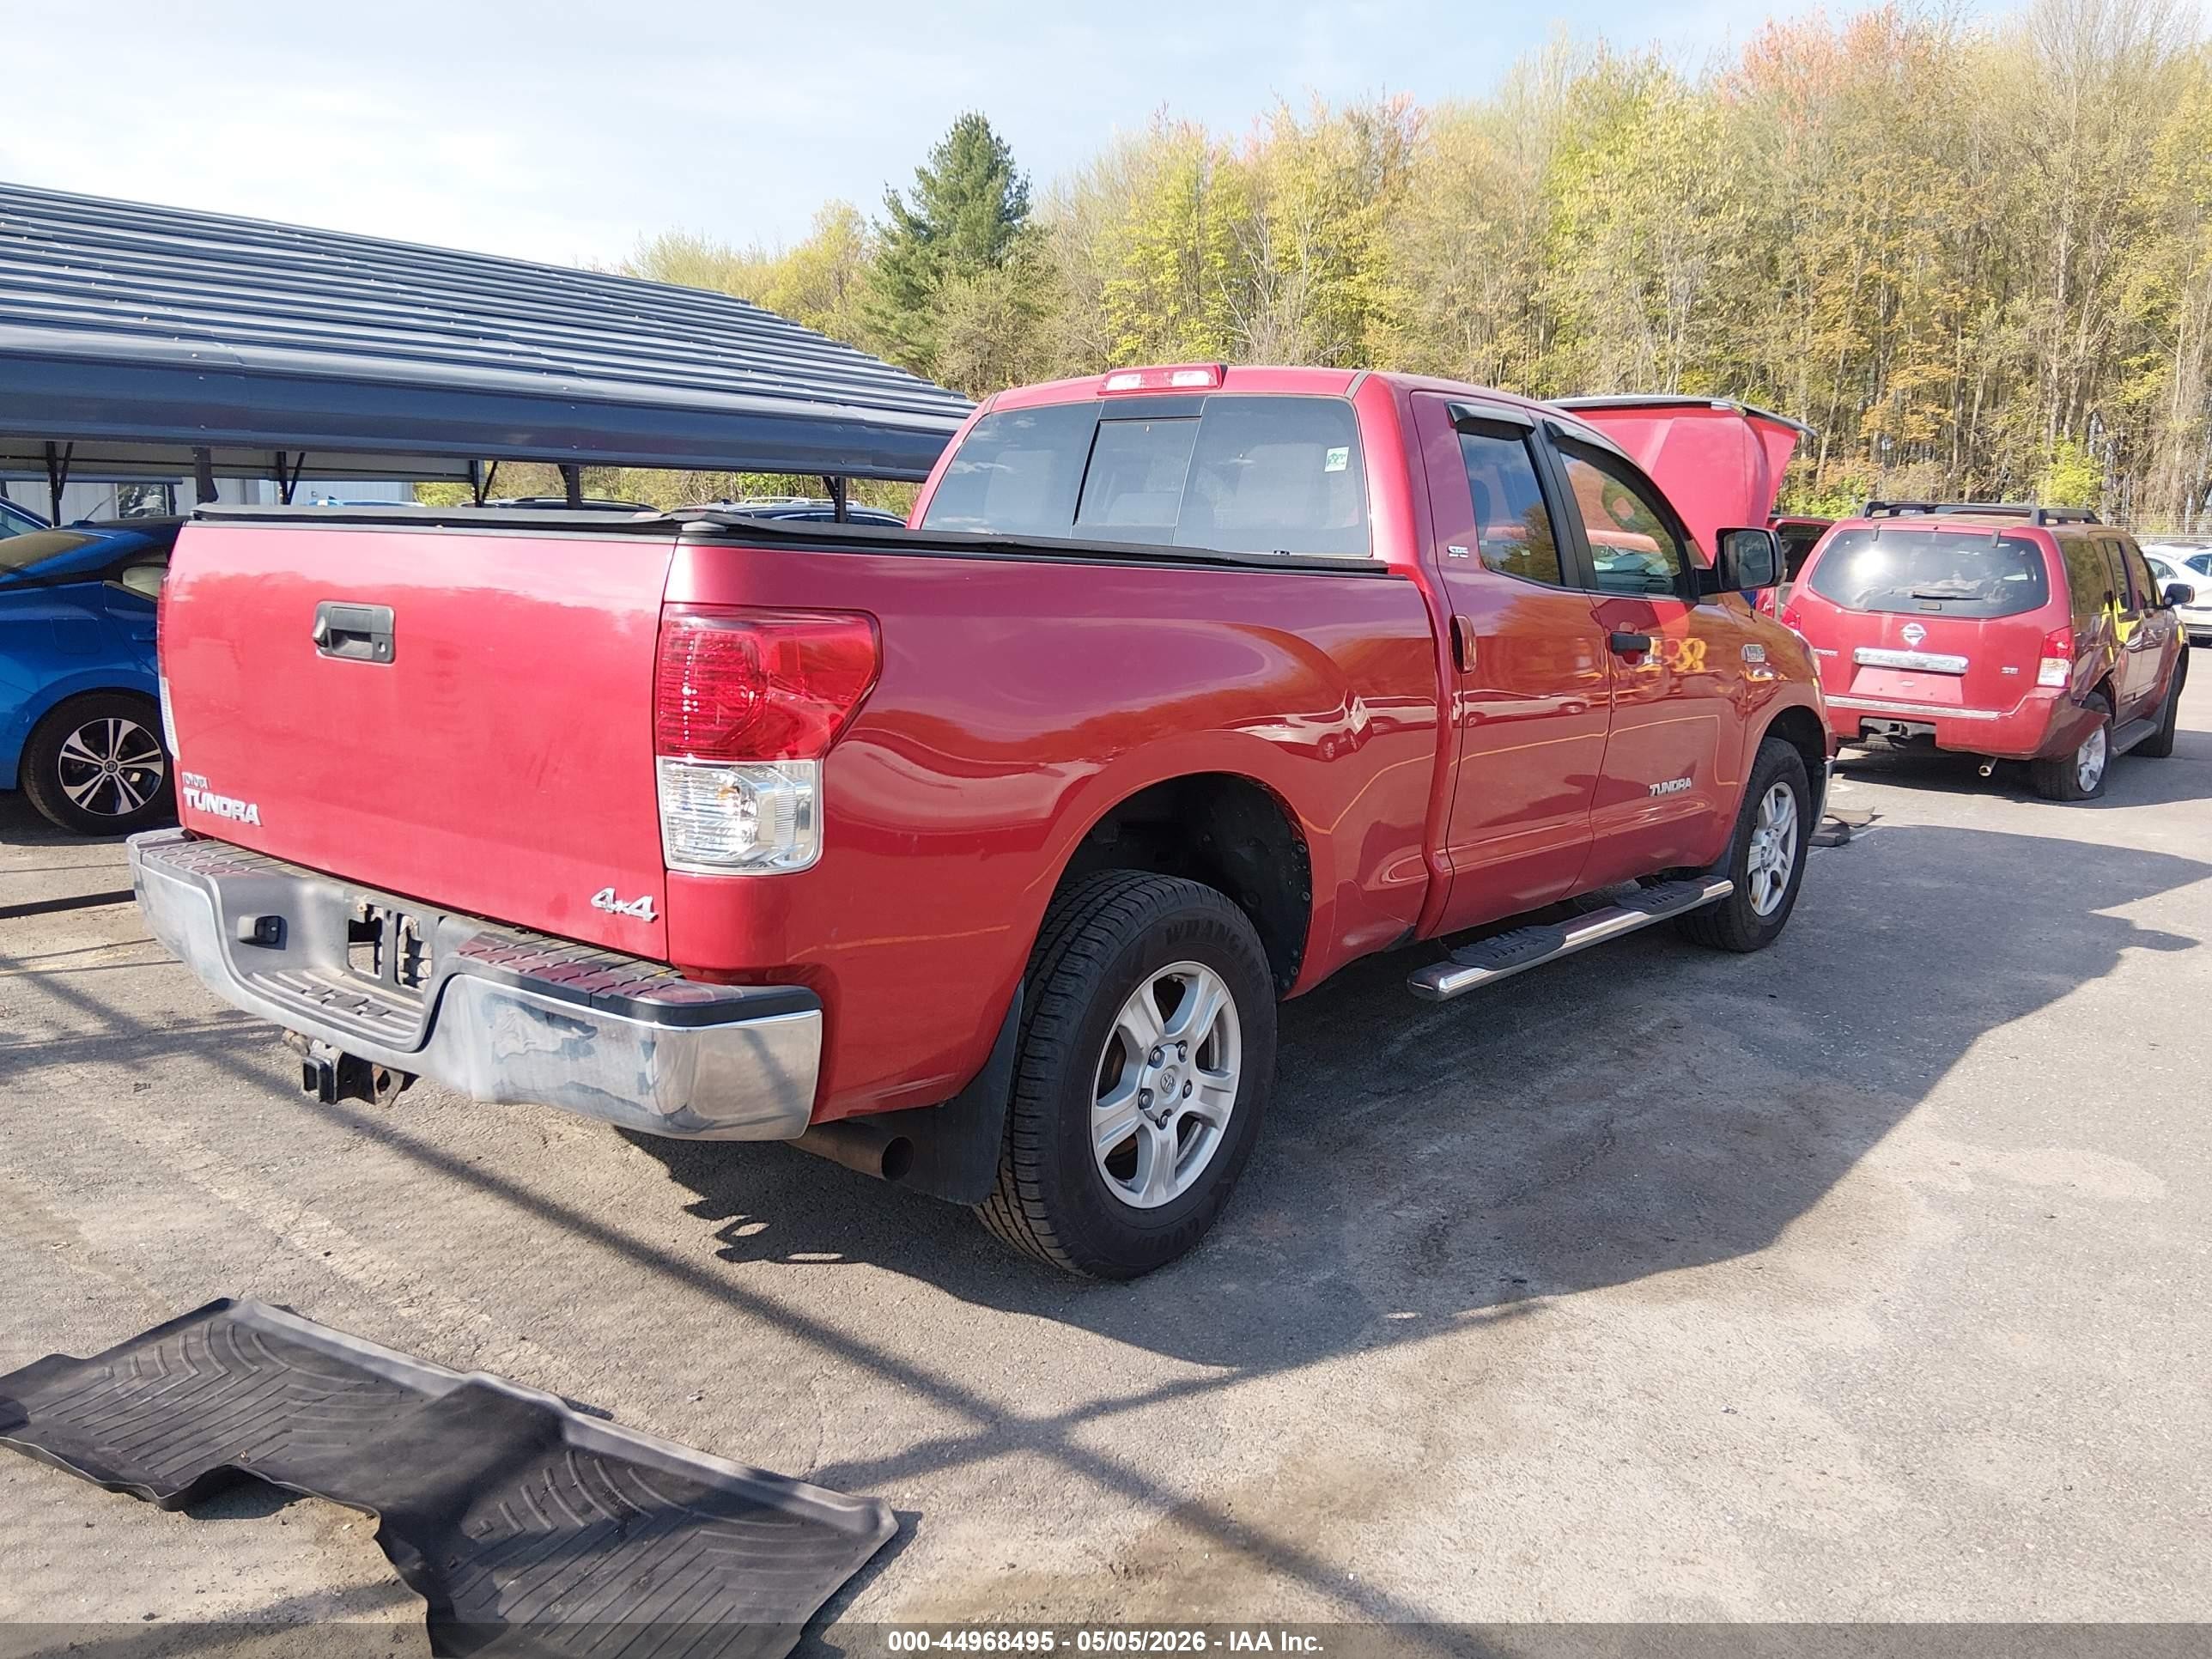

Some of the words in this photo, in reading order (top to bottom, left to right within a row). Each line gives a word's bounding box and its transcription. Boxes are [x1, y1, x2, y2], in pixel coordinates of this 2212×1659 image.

[1649, 777, 1692, 797] TUNDRA
[182, 786, 262, 826] TUNDRA
[590, 887, 659, 921] 4x4
